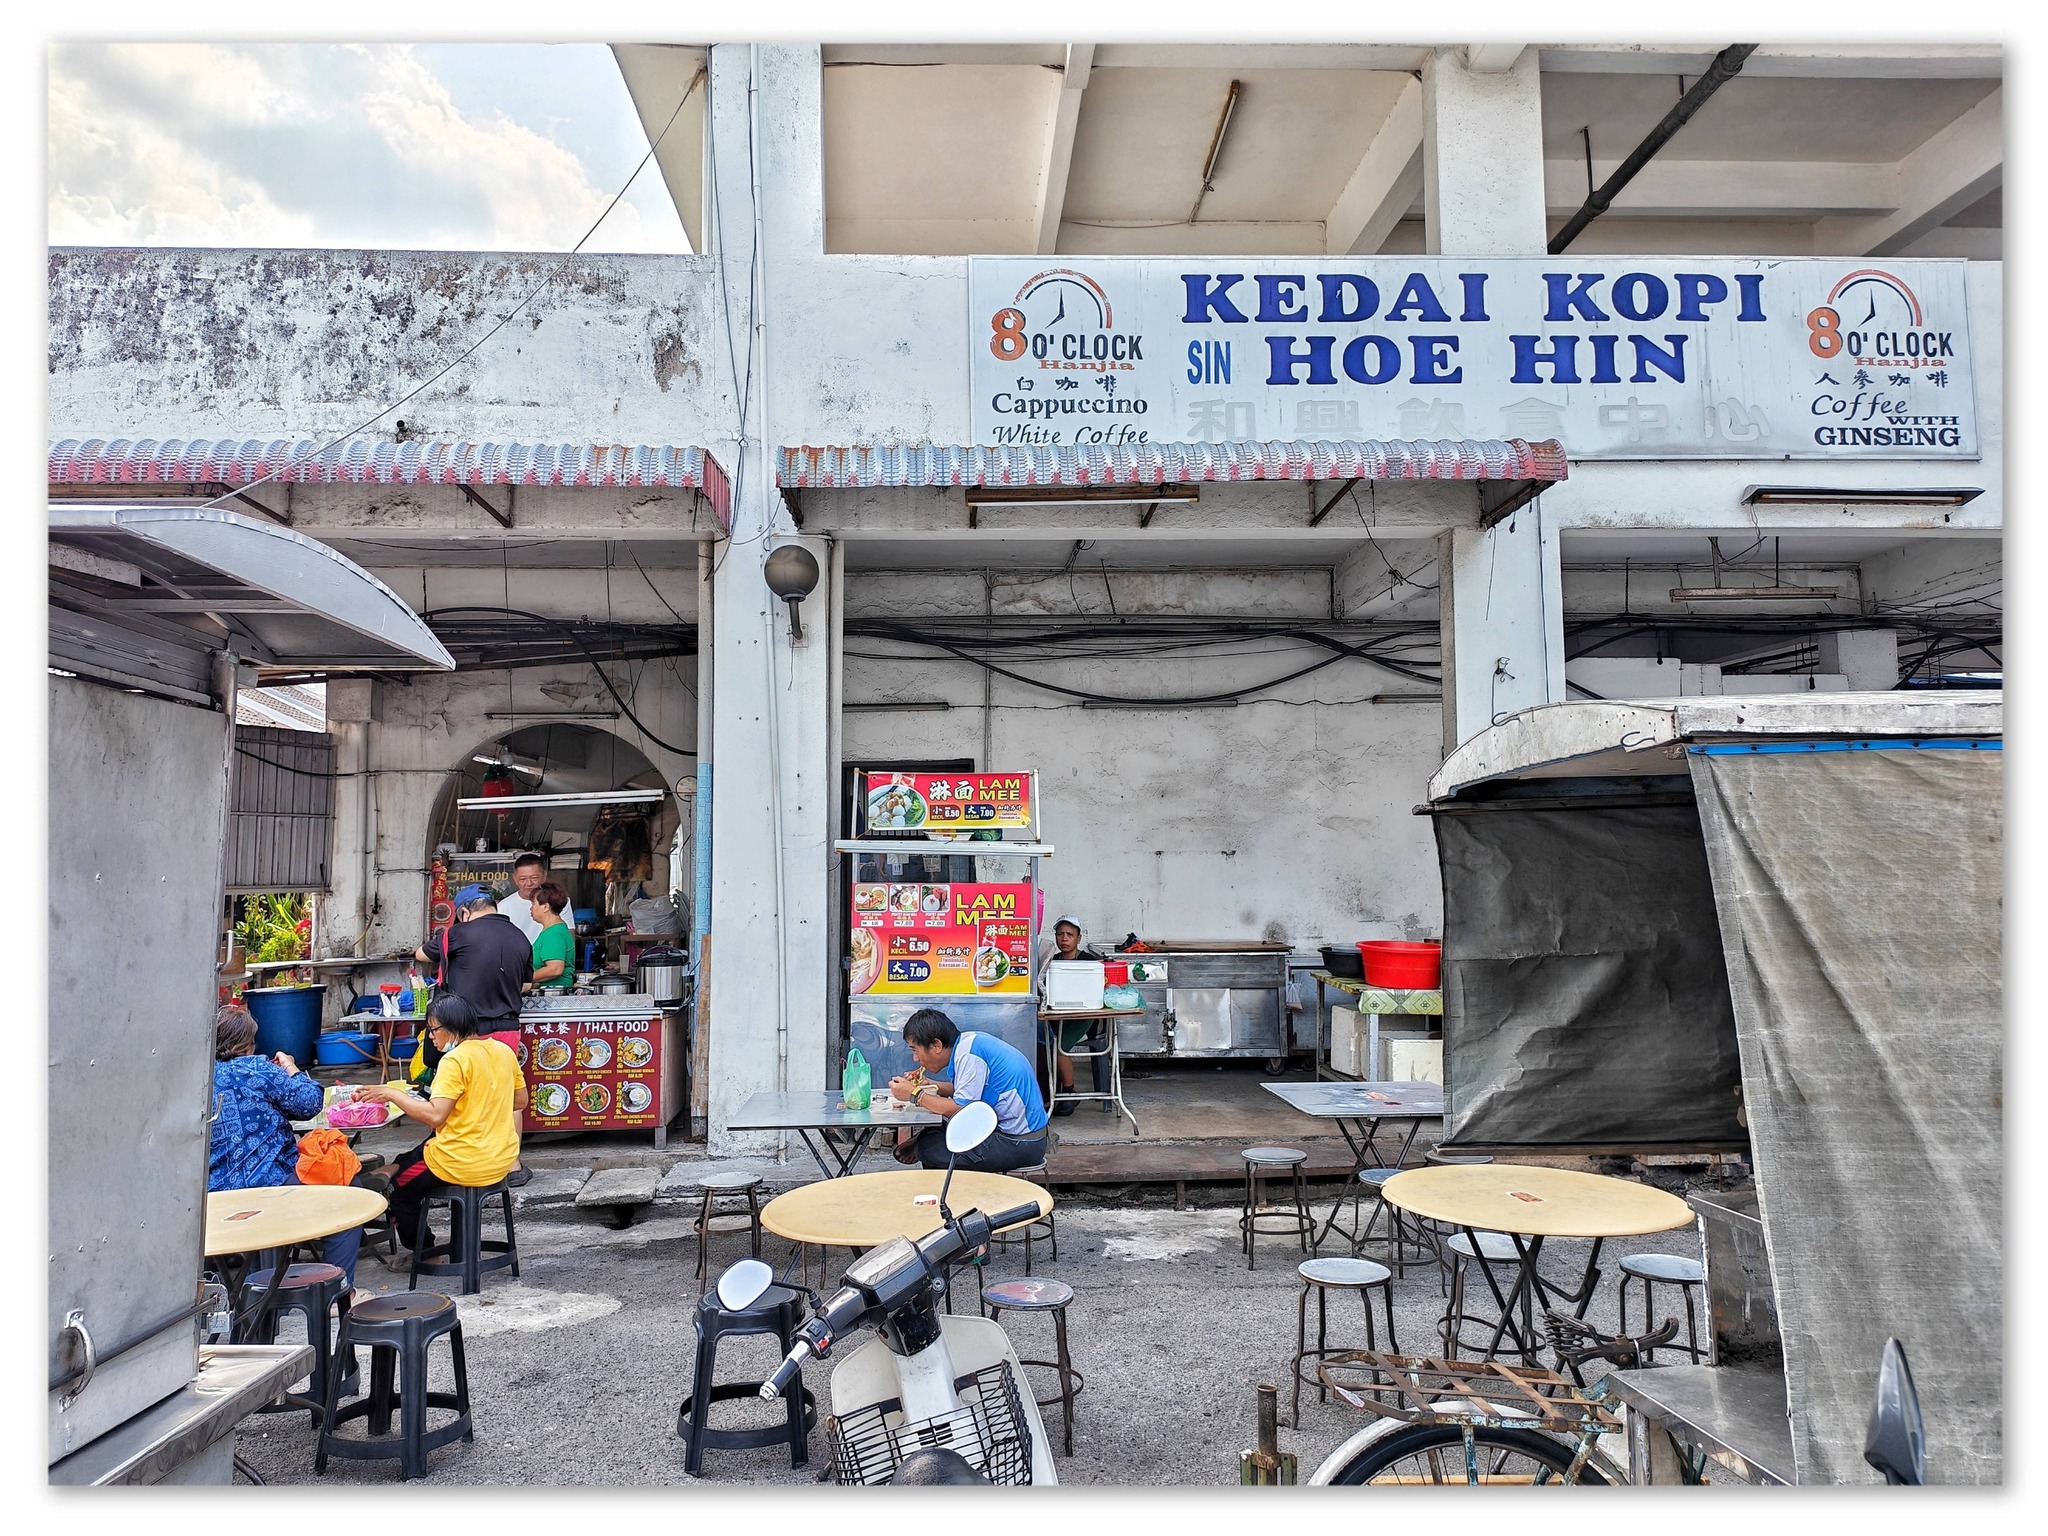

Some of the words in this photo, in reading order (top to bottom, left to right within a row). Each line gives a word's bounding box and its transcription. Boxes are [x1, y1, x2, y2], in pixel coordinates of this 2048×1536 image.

[1181, 272, 1490, 324] KEDAI
[1541, 272, 1767, 323] KOPI
[990, 307, 1029, 361] 8
[1807, 306, 1843, 358] 8
[1038, 359, 1135, 373] Hanjia
[1187, 339, 1231, 385] SIN
[1265, 335, 1463, 385] HOE
[1509, 334, 1689, 384] HIN
[1854, 356, 1947, 369] Hanjia
[1016, 374, 1117, 393] 白咖啡
[992, 392, 1148, 420] Cappuccino
[1811, 392, 1908, 421] Coffee
[1885, 415, 1961, 426] WITH
[993, 423, 1062, 445] White
[1073, 424, 1149, 446] Coffee
[1814, 426, 1961, 447] GINSENG
[979, 779, 1020, 789] LAM
[979, 790, 1020, 800] MEE
[932, 805, 943, 815] 小
[980, 809, 994, 817] 7.00
[455, 871, 479, 881] THAI
[481, 871, 509, 881] FOOD
[956, 893, 1015, 909] LAM
[893, 936, 907, 947] 小
[909, 941, 930, 952] 6.50
[892, 960, 905, 974] 大
[909, 966, 928, 977] 7.00
[584, 1021, 614, 1034] THAI
[616, 1020, 649, 1033] FOOD
